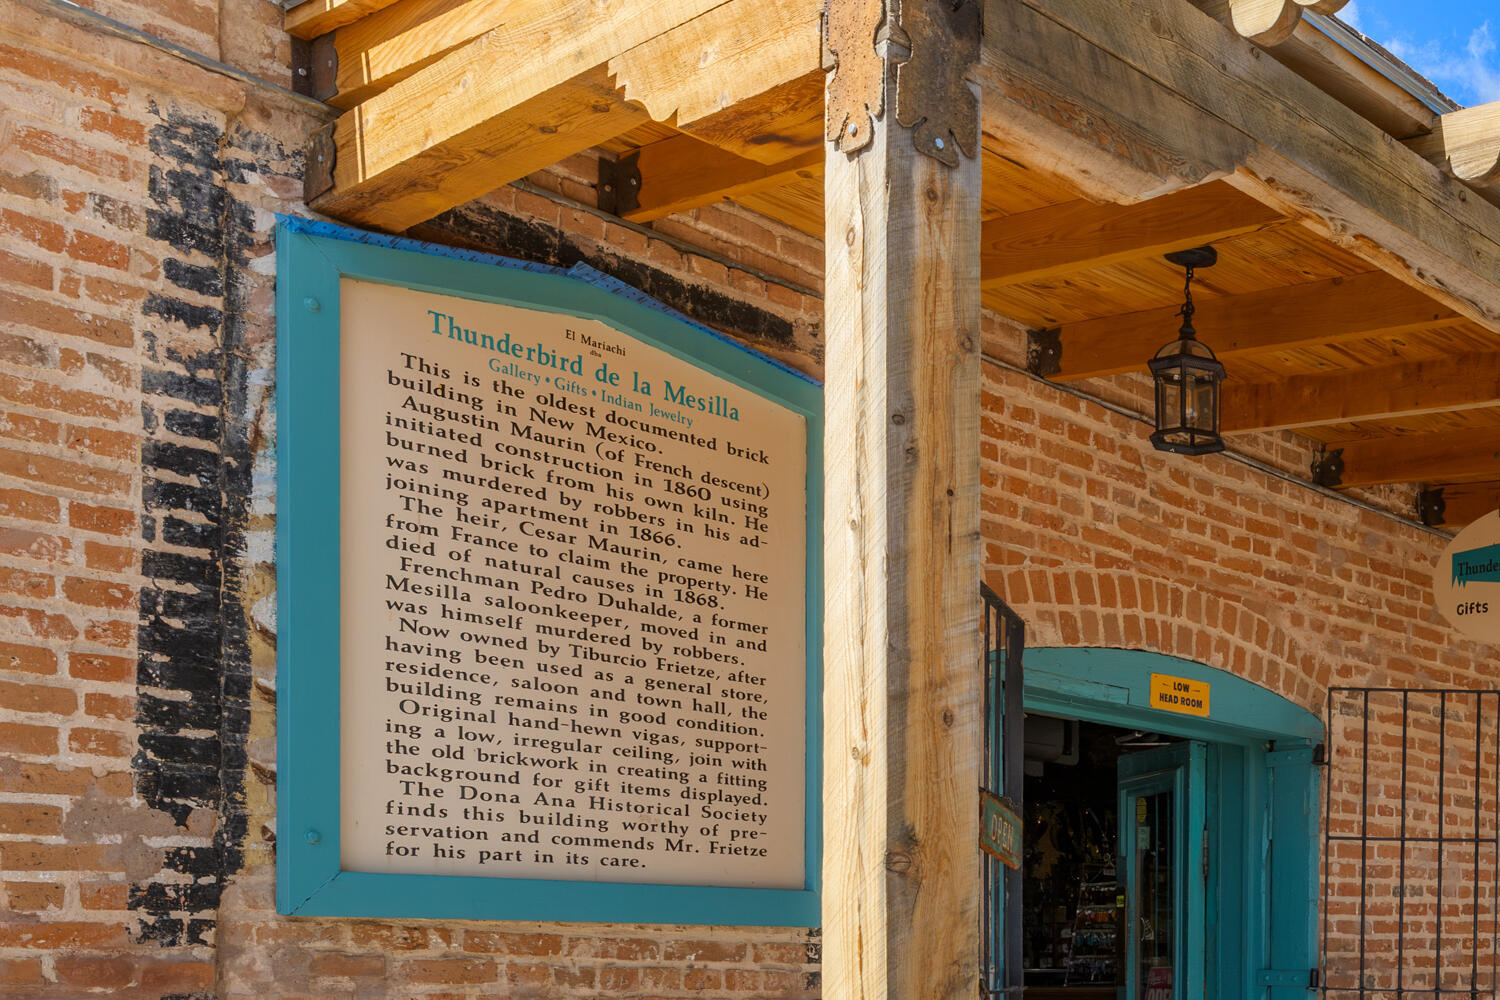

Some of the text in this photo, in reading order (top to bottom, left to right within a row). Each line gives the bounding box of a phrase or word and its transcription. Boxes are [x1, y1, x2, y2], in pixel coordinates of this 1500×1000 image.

[427, 310, 739, 421] Thunderbird de la Mesilla
[566, 329, 625, 356] El Mariachi
[387, 370, 662, 454] building in New Mexico.
[401, 353, 768, 464] This is the oldest documented brick
[489, 358, 693, 429] Gallery Gifts Indian Jewelry
[386, 412, 768, 518] initiated construction in 1860 using
[401, 396, 769, 500] Augustin Maurin (of French descent)
[386, 431, 768, 532] burned brick from his own kiln. He
[386, 457, 767, 548] was murdered by robbers in his ad-
[386, 473, 681, 548] joining apartment in 1866.
[400, 495, 768, 583] The heir, Cesar Maurin, came here
[386, 535, 724, 610] died of natural causes in 1868.
[400, 556, 768, 635] Frenchman Pedro Duhalde, a former
[386, 574, 766, 652] Mesilla saloonkeeper, moved in and
[386, 600, 744, 665] was himself murdered by robbers.
[1456, 602, 1489, 616] Gifts
[385, 662, 767, 720] residence, saloon and town hall, the
[386, 636, 767, 704] having been used as a general store,
[1159, 692, 1203, 709] HEAD ROOM
[1173, 681, 1190, 693] LOW
[386, 677, 763, 737] building remains in good condition.
[399, 699, 767, 754] Original hand-hewn vigas, support-
[386, 719, 767, 771] ing a low, irregular ceiling, join with
[387, 739, 767, 792] the old brickwork in creating a fitting
[386, 759, 767, 806] background for gift items displayed.
[400, 780, 767, 825] The Dona Ana Historical Society
[386, 825, 767, 857] servation and commends Mr. Frietze
[386, 841, 645, 867] for his part in its care.
[991, 813, 1014, 854] OPEN
